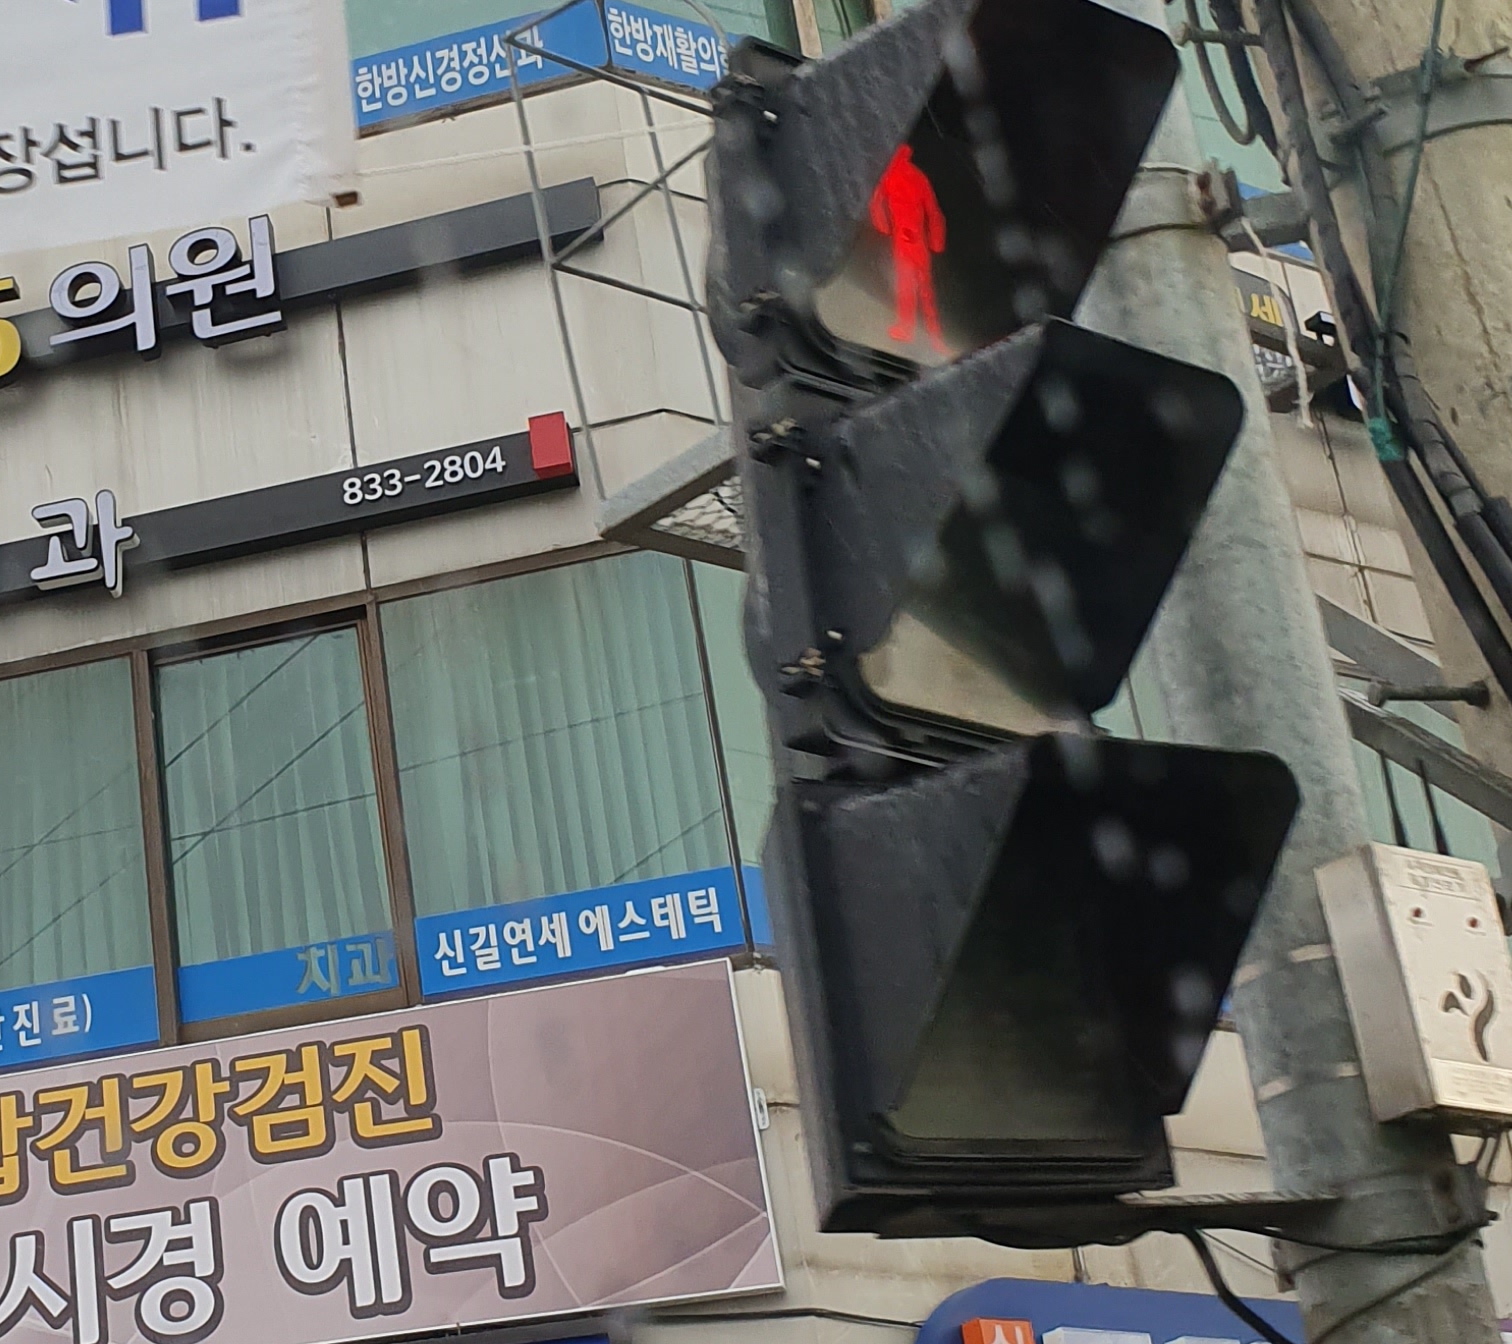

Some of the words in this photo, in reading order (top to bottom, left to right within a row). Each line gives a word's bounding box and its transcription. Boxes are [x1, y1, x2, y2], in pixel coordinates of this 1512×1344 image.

[354, 25, 544, 114] 한방신경정신과
[342, 444, 507, 506] 833-2804
[274, 1151, 548, 1319] 예약
